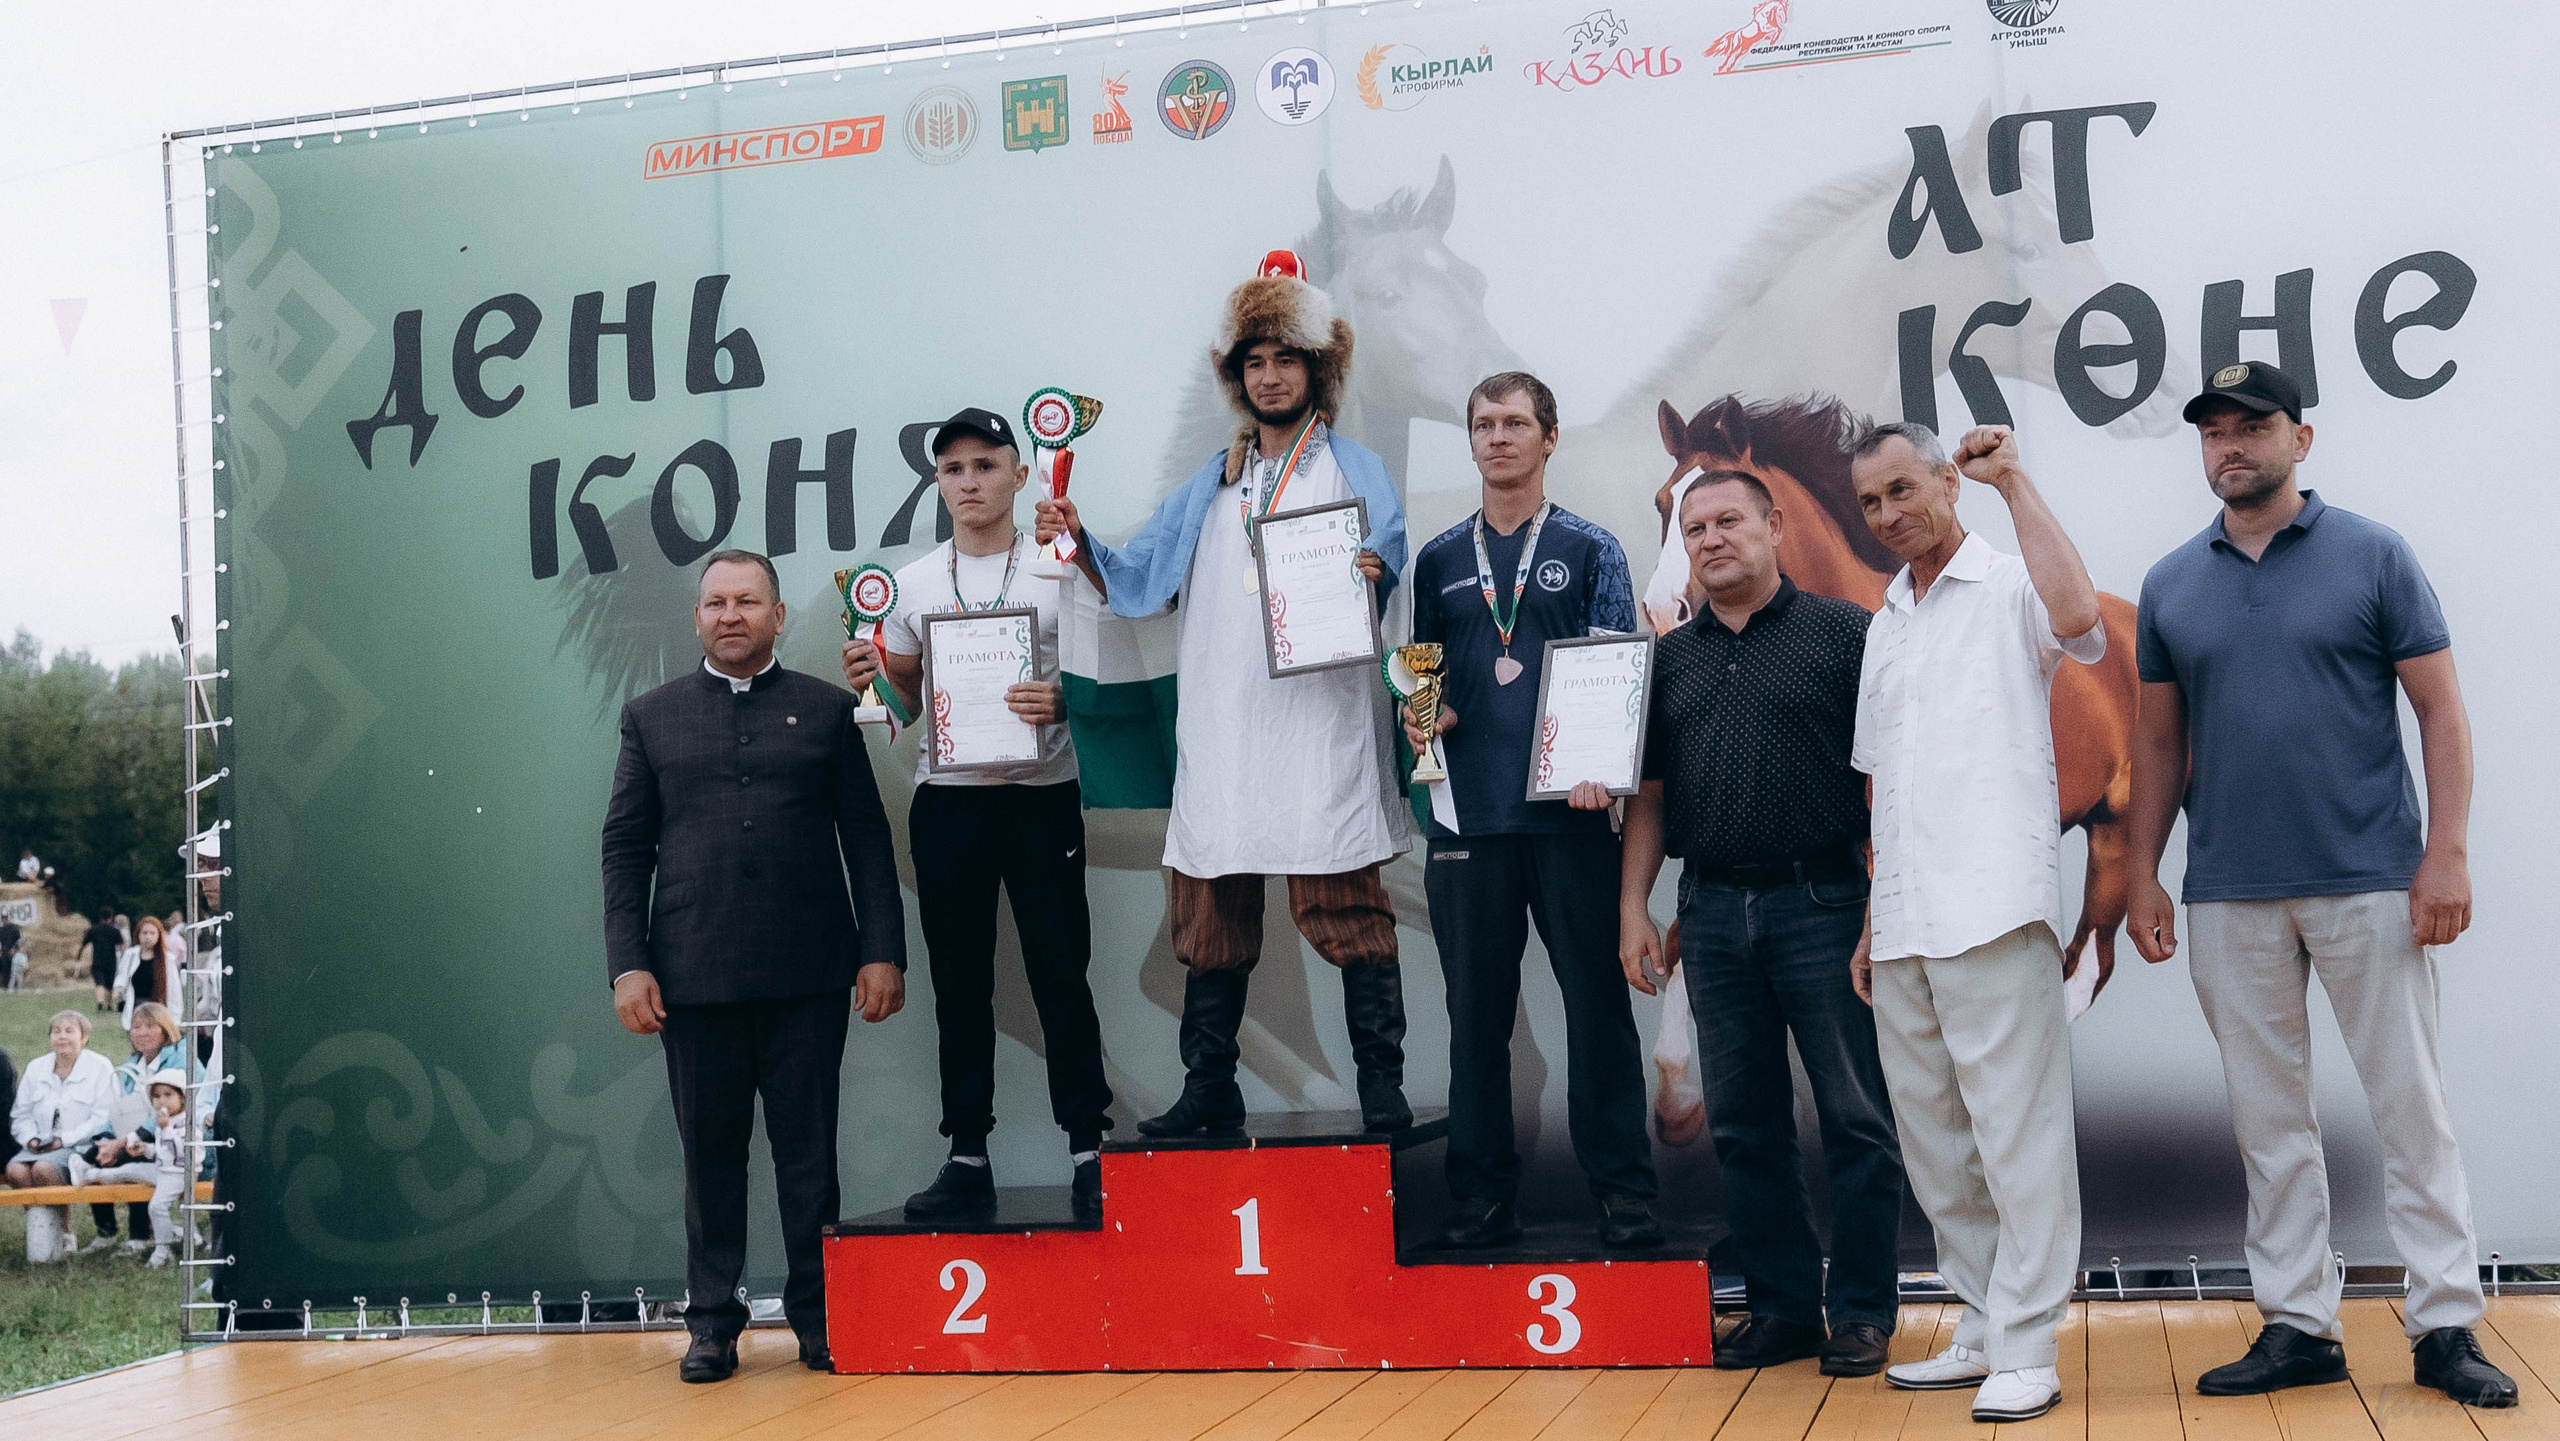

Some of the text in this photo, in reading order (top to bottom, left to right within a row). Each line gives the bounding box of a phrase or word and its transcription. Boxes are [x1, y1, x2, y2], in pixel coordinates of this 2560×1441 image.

[1750, 42, 1801, 55] ФЕДЕРАЦИЯ
[1803, 35, 1865, 49] КОНЕВОДСТВА
[1876, 29, 1916, 40] КОННОГО
[1917, 24, 1951, 35] СПОРТА
[1990, 25, 2066, 42] АГРОФИРМА
[2009, 37, 2048, 49] УНЫШ
[1798, 38, 1903, 57] РЕСПУБЛИКИ ТАТАРСТАН
[1391, 52, 1494, 84] КЫРЛАЙ
[1523, 45, 1683, 93] КАЗАНЬ
[1392, 78, 1464, 95] АГРОФИРМА
[651, 120, 881, 173] МИНСПОРТ
[1093, 131, 1133, 146] ПОБЕДА!
[1281, 543, 1347, 565] ГРАМОТА
[948, 650, 1016, 665] ГРАМОТА
[1563, 675, 1628, 690] ГРАМОТА
[1232, 1197, 1269, 1276] 1
[938, 1258, 988, 1336] 2
[1526, 1273, 1582, 1355] 3
